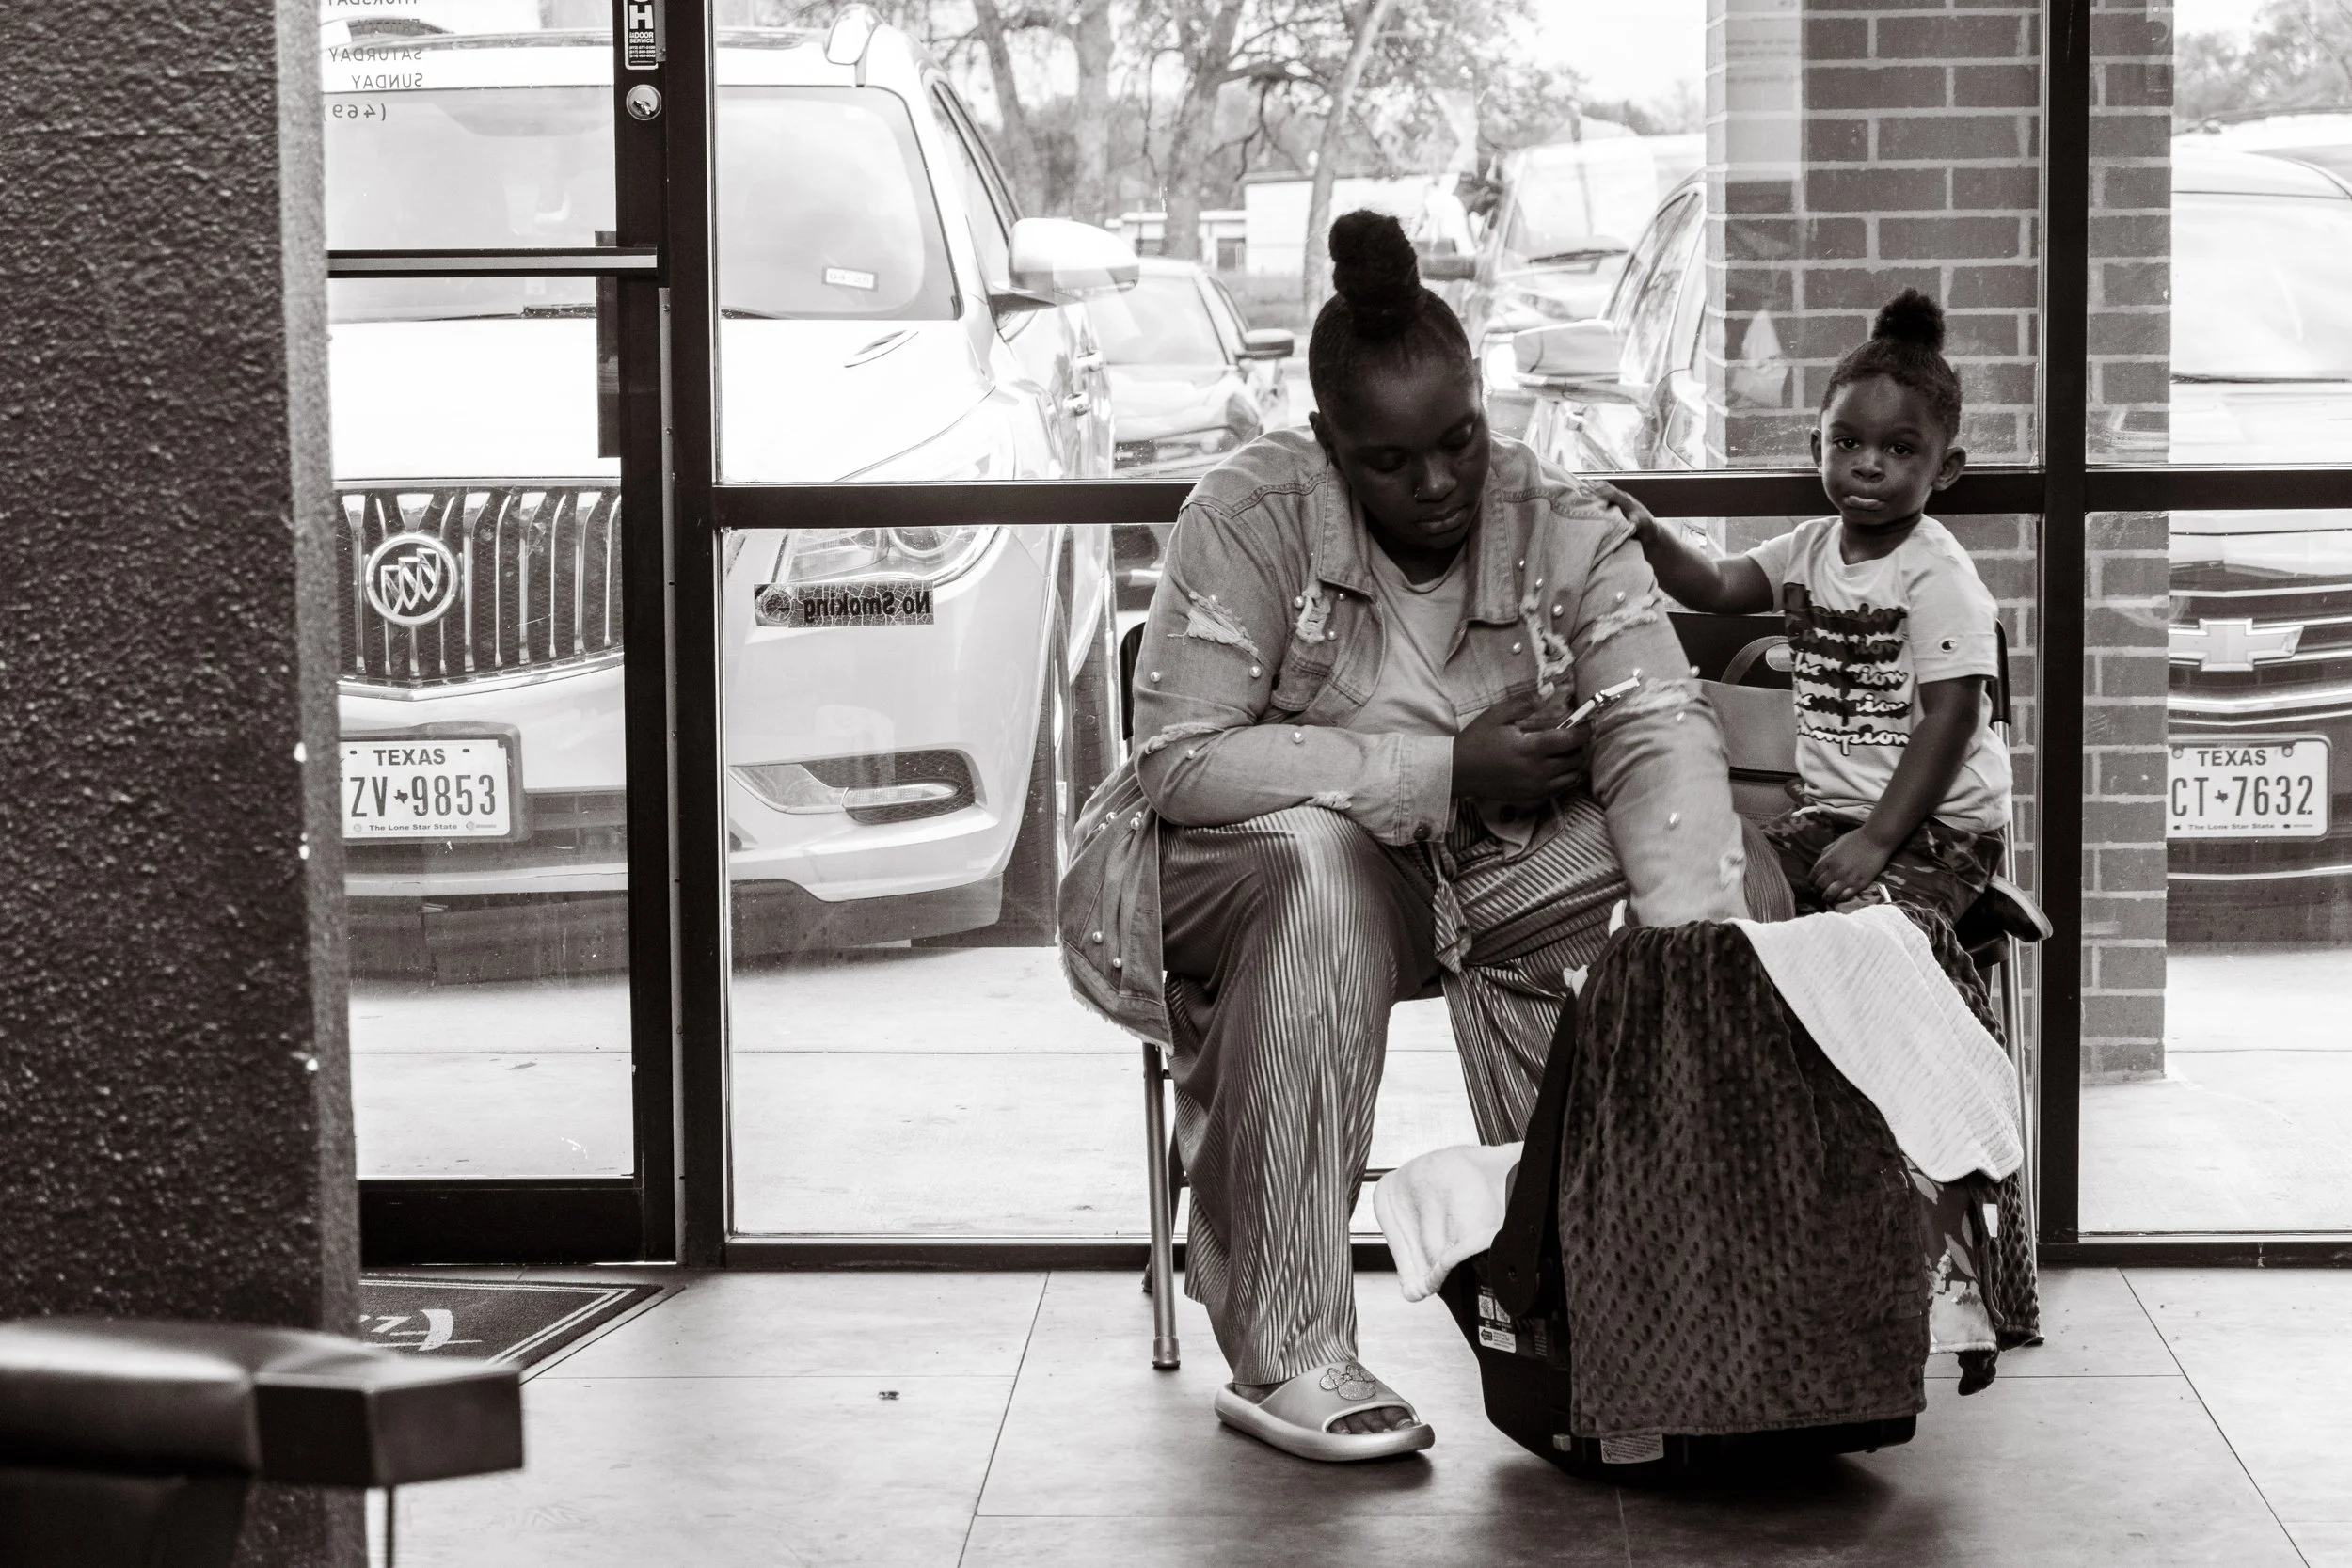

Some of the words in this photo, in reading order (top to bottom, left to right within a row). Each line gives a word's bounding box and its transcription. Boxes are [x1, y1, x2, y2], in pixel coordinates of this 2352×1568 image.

[629, 5, 654, 29] H
[373, 748, 446, 766] TEXAS
[2197, 749, 2267, 767] TEXAS
[340, 776, 389, 817] ZV
[411, 774, 496, 816] 9853
